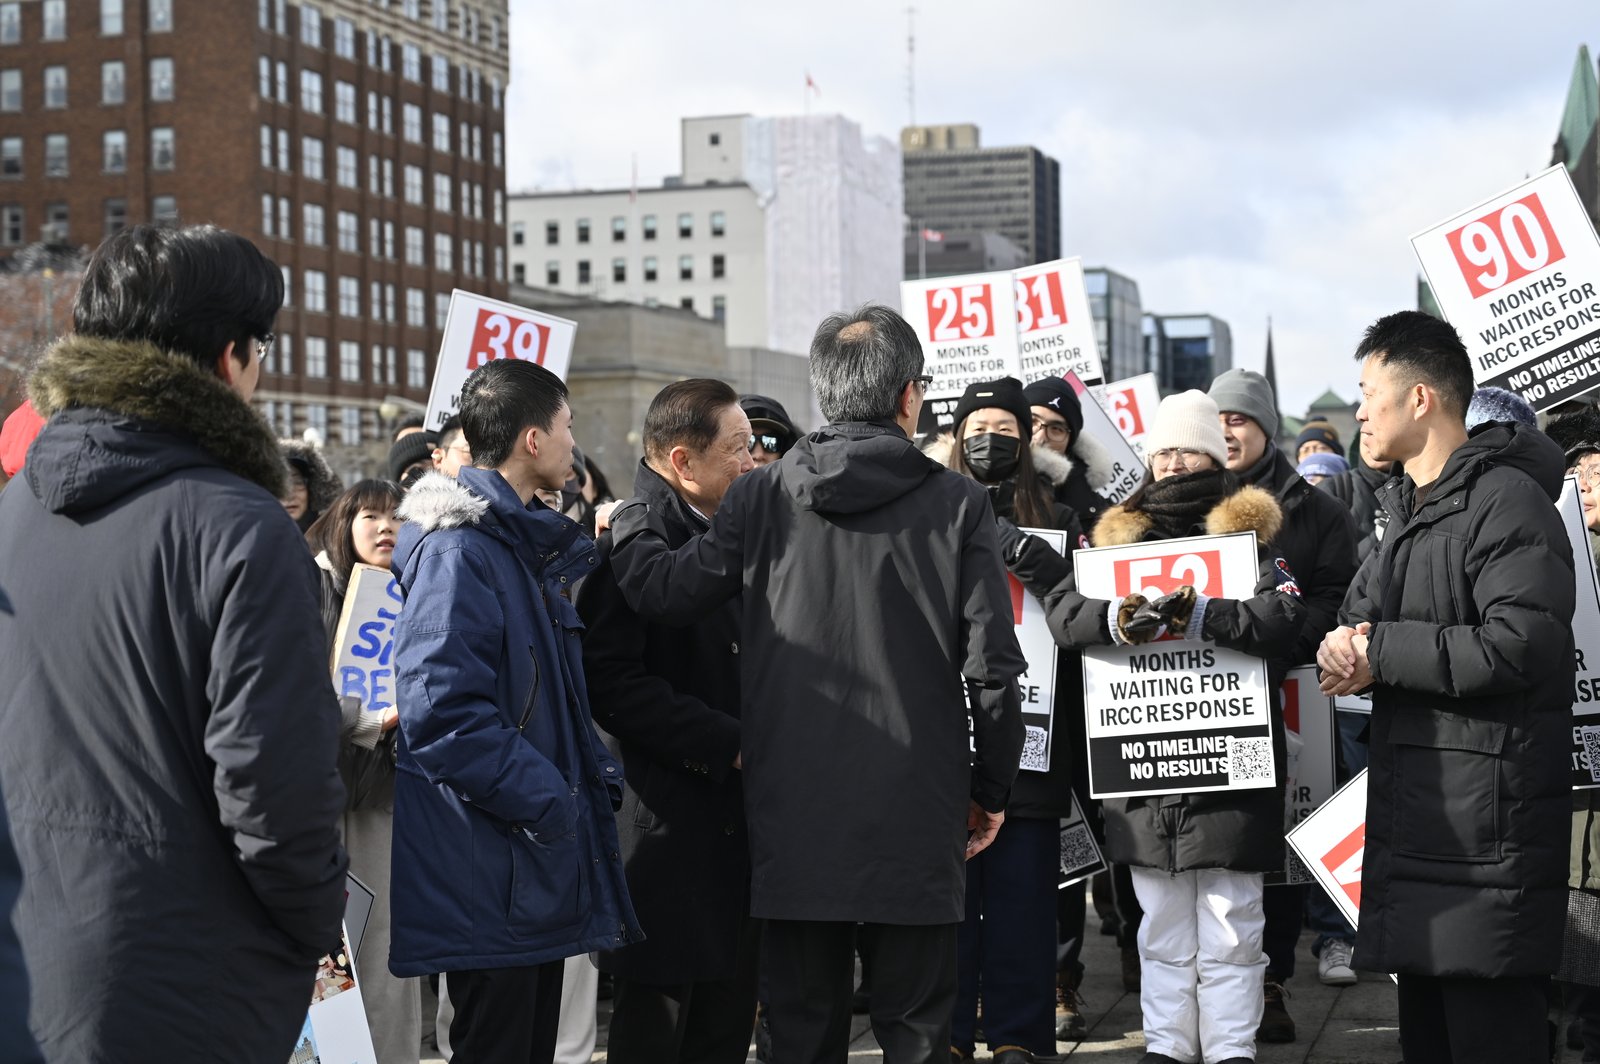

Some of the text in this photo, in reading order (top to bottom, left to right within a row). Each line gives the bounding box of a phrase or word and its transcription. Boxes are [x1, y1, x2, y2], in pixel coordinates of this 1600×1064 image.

[1460, 202, 1549, 289] 90
[931, 285, 988, 341] 25
[1479, 282, 1597, 346] WAITING FOR
[1489, 272, 1567, 318] MONTHS
[476, 313, 541, 367] 39
[937, 344, 989, 359] MONTHS
[1478, 303, 1600, 372] IRCC RESPONS
[926, 359, 1005, 375] WAITING FOR
[1021, 347, 1082, 370] ITING FOR
[1507, 336, 1600, 391] NO TIMELINE
[1522, 357, 1600, 404] NO RESULT
[1109, 391, 1136, 438] 6
[1109, 468, 1141, 504] ONSE
[1129, 649, 1215, 674] MONTHS
[1110, 672, 1240, 701] WAITING FOR
[1100, 697, 1255, 727] IRCC RESPONSE
[1121, 742, 1145, 760] NO
[1130, 757, 1229, 780] NO RESULTS
